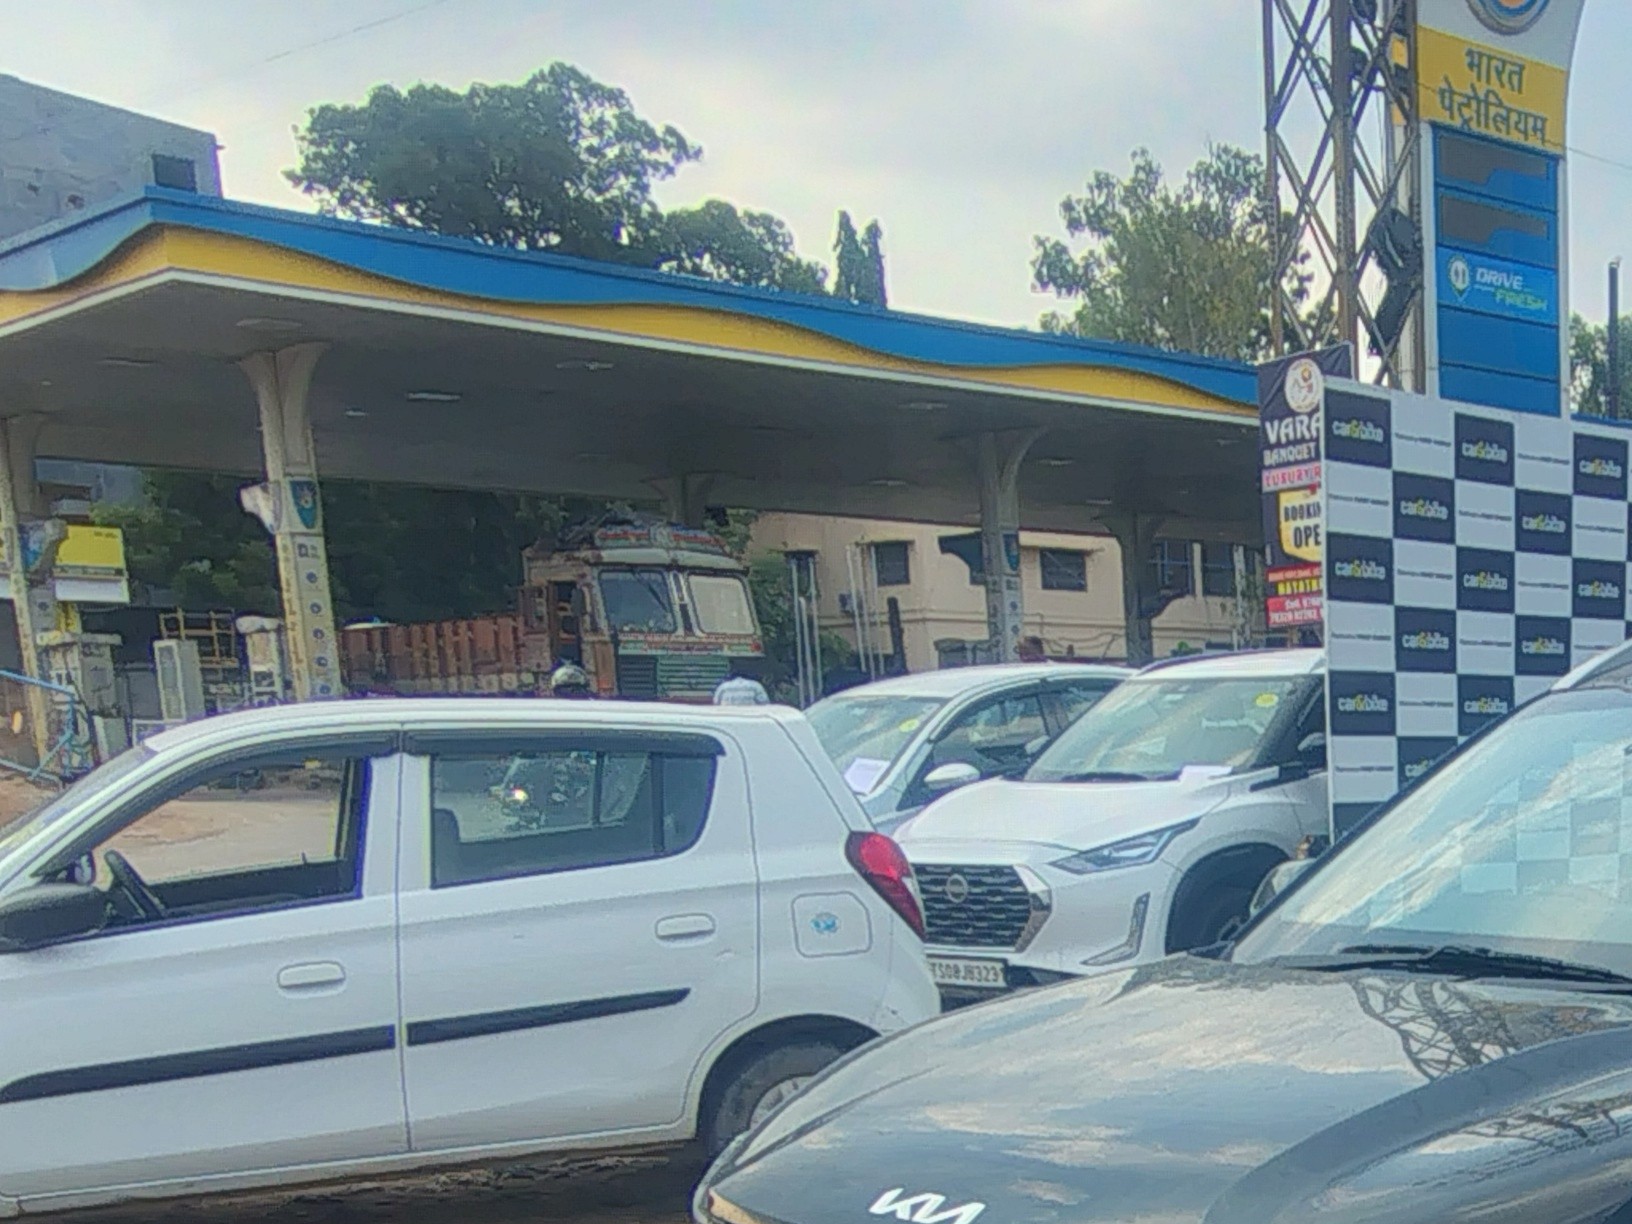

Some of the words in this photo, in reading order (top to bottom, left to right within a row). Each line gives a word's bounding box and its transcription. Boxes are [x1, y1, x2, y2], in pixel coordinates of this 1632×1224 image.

[1465, 47, 1526, 95] भारत
[1438, 73, 1549, 146] पेट्रोलियम
[1475, 267, 1524, 291] DRIVE
[1263, 441, 1317, 467] BANQUET
[1294, 523, 1322, 549] OPE
